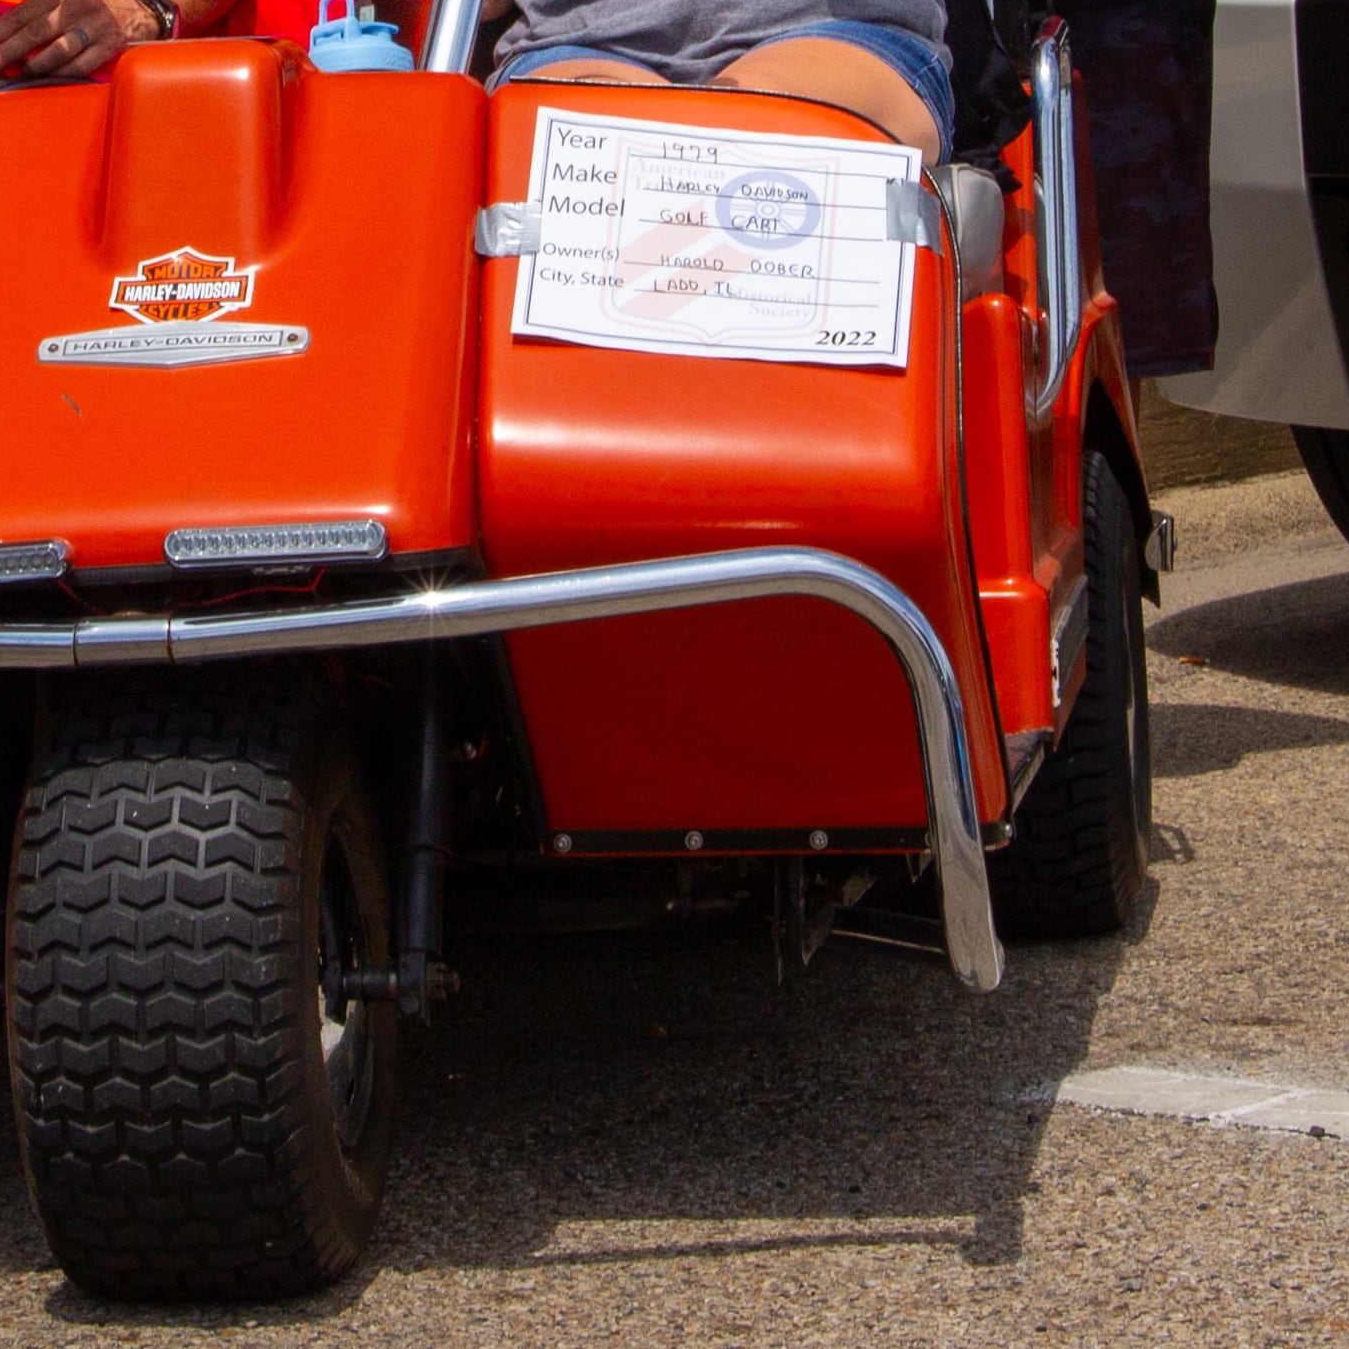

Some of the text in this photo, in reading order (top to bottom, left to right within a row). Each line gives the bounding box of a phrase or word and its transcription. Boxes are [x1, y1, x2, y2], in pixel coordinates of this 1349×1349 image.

[557, 127, 718, 164] Year 1979
[552, 162, 618, 185] Make
[741, 184, 809, 201] DAVIDSON
[549, 195, 779, 231] Model GOLF CART
[152, 261, 219, 279] MOTOR
[543, 242, 816, 279] Owner(s) HAROLD DOBER
[124, 281, 240, 302] HARLEY-DAVIDSON
[539, 267, 575, 287] City,
[581, 272, 624, 288] State
[714, 281, 735, 296] IL
[148, 303, 208, 321] CYCLES
[73, 333, 274, 352] HARLEY-DAVIDSON
[816, 330, 878, 346] 2022
